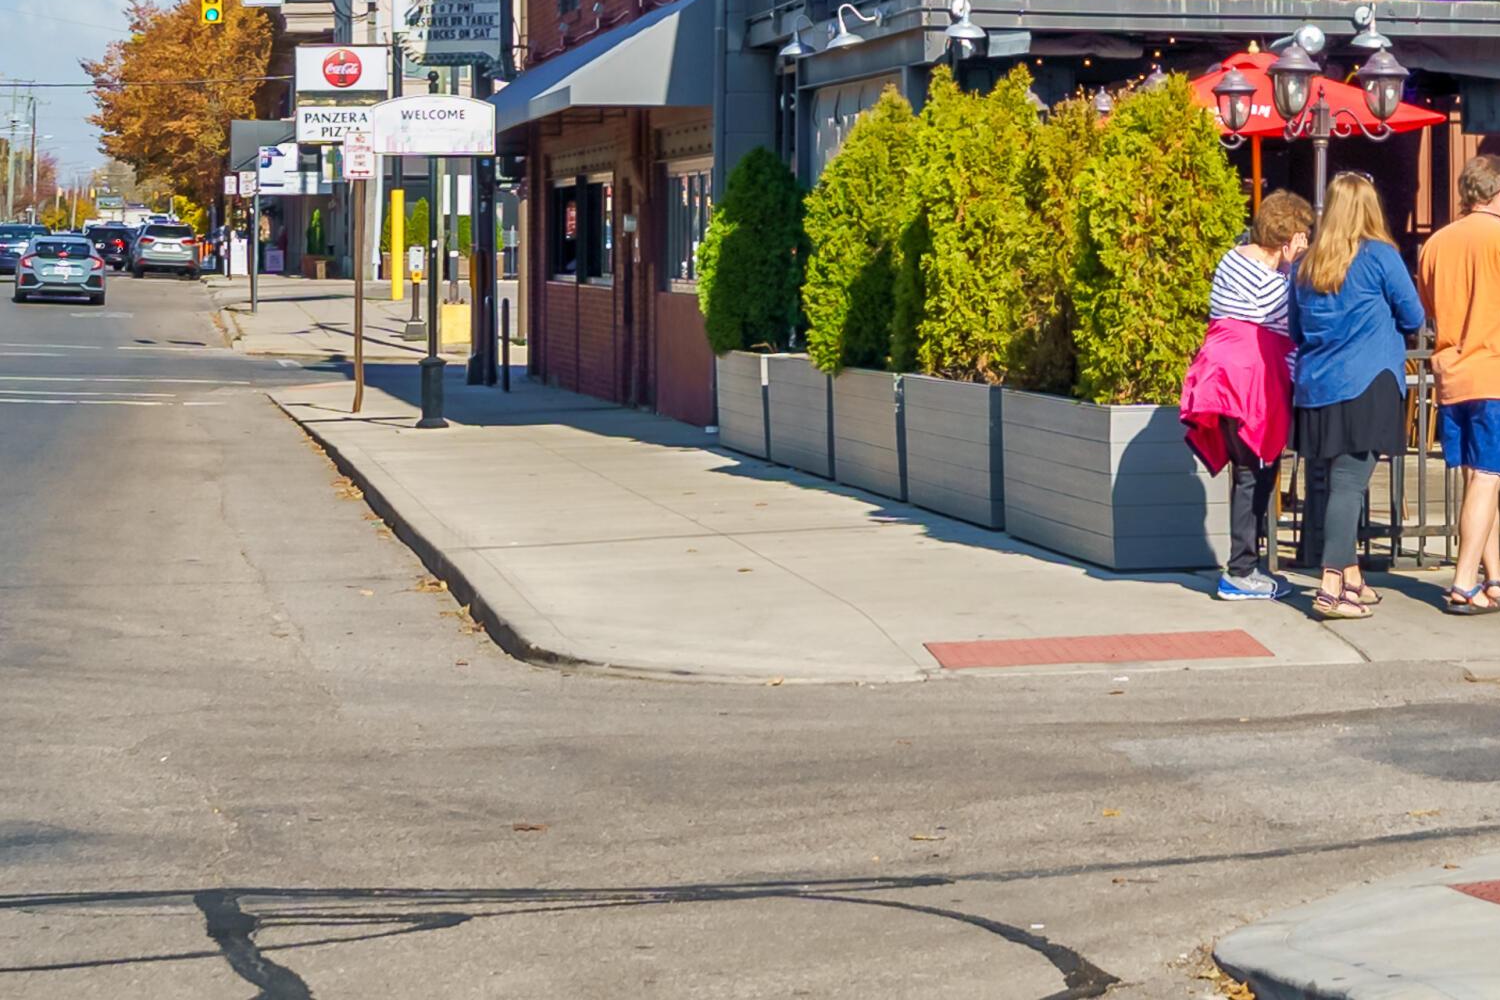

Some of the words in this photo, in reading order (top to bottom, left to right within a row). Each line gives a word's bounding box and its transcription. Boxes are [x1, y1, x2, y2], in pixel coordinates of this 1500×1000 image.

[466, 15, 495, 26] TABLE
[473, 28, 491, 40] SAT
[304, 112, 368, 124] PANZERA
[400, 109, 465, 120] WELCOME
